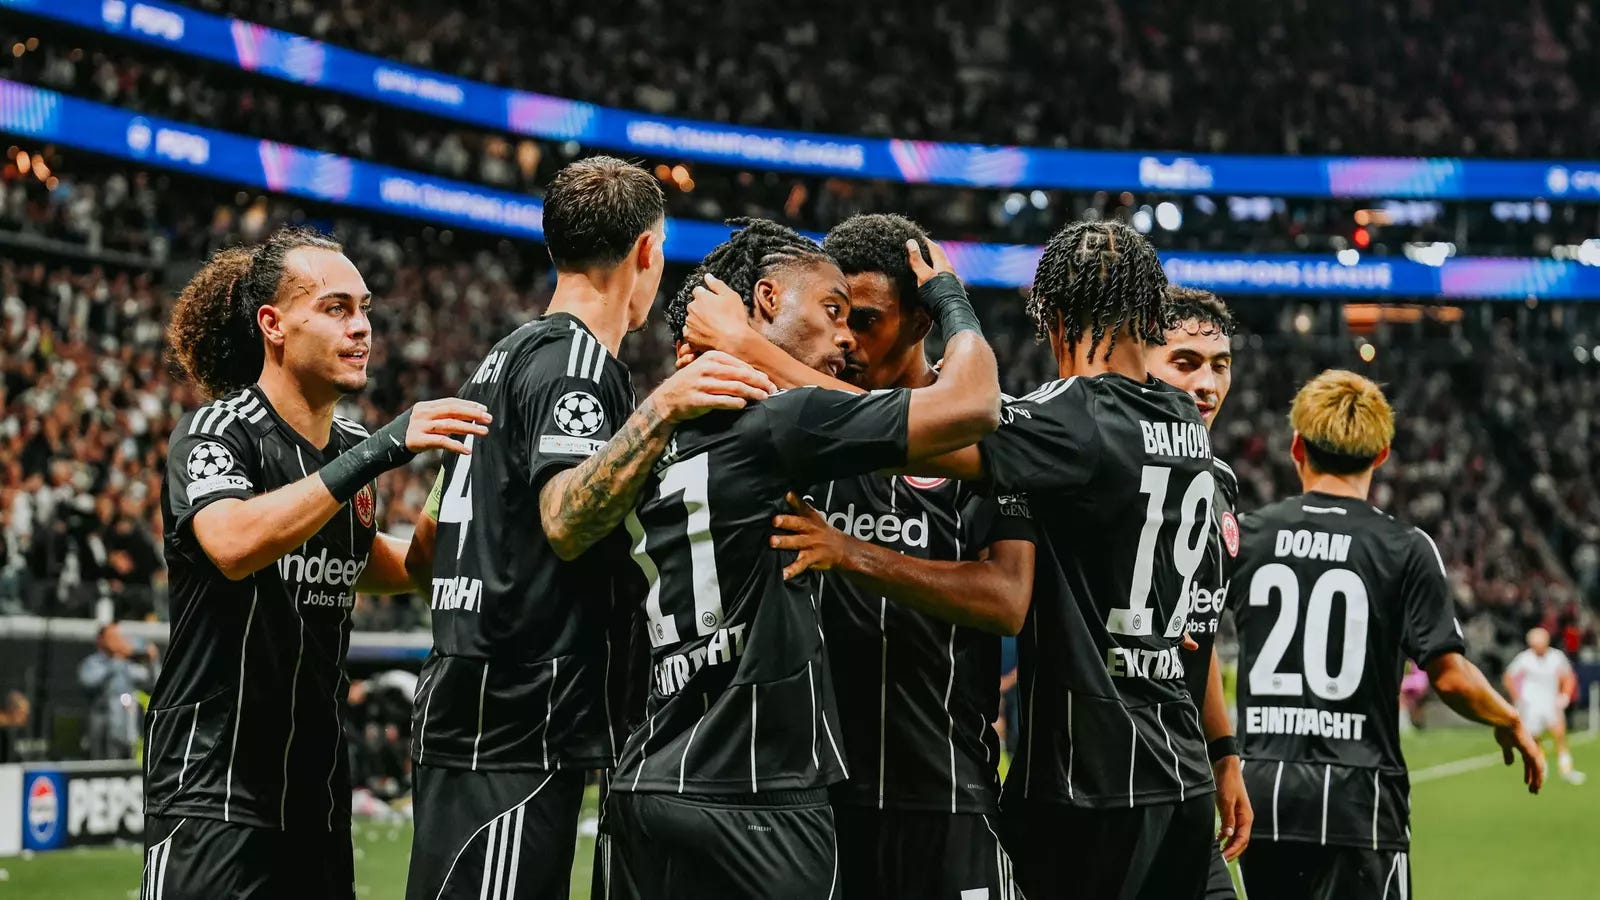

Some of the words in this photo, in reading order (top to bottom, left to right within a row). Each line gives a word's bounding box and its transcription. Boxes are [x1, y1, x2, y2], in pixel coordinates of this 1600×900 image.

[1139, 419, 1212, 460] BAHOYA
[803, 496, 929, 549] deed
[1274, 529, 1352, 562] DOAN
[1106, 465, 1215, 638] 19
[303, 590, 335, 607] Jobs
[1185, 618, 1206, 633] obs
[1249, 563, 1369, 700] 20
[67, 775, 143, 836] PEPS
